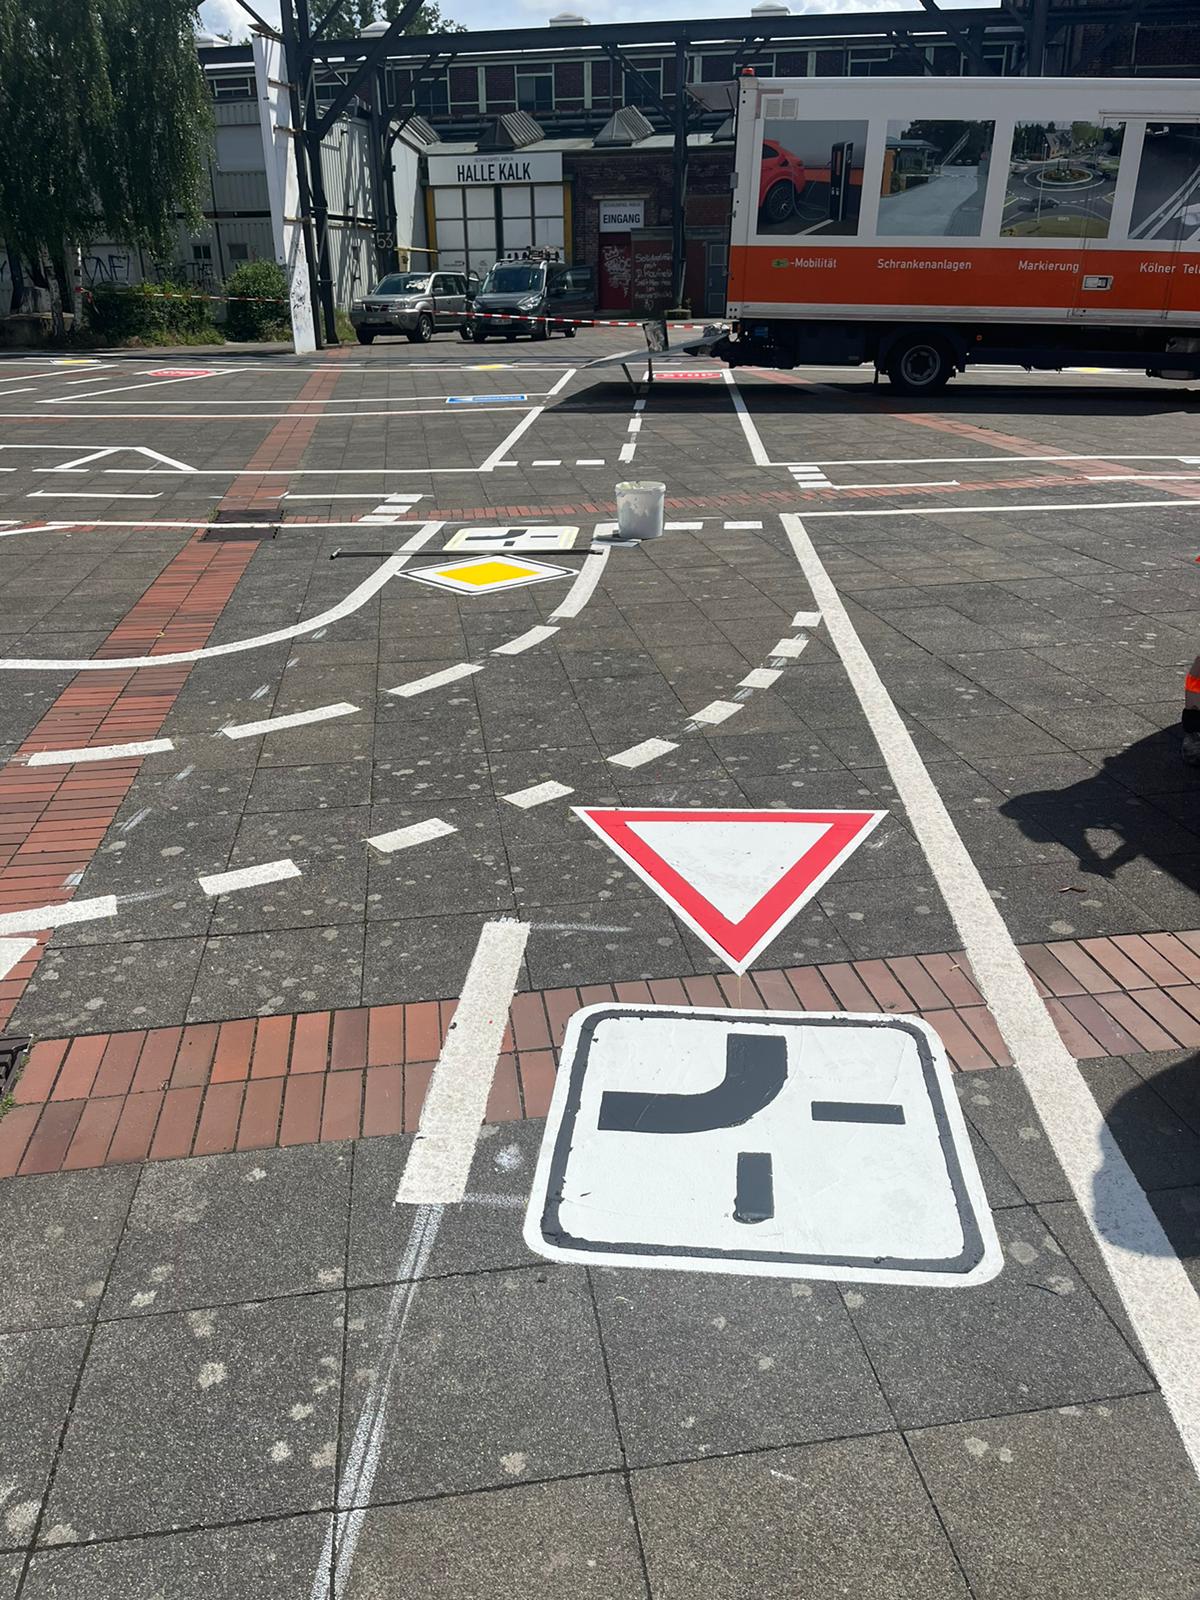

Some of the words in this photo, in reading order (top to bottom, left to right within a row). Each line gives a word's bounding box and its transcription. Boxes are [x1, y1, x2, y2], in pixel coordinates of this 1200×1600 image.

[457, 164, 495, 182] HALLE
[499, 162, 531, 180] KALK
[603, 213, 641, 224] EINGANG
[376, 232, 394, 249] 53
[877, 259, 972, 272] Schrankenanlagen
[1018, 260, 1080, 273] Markierung
[1139, 262, 1176, 273] Kölner
